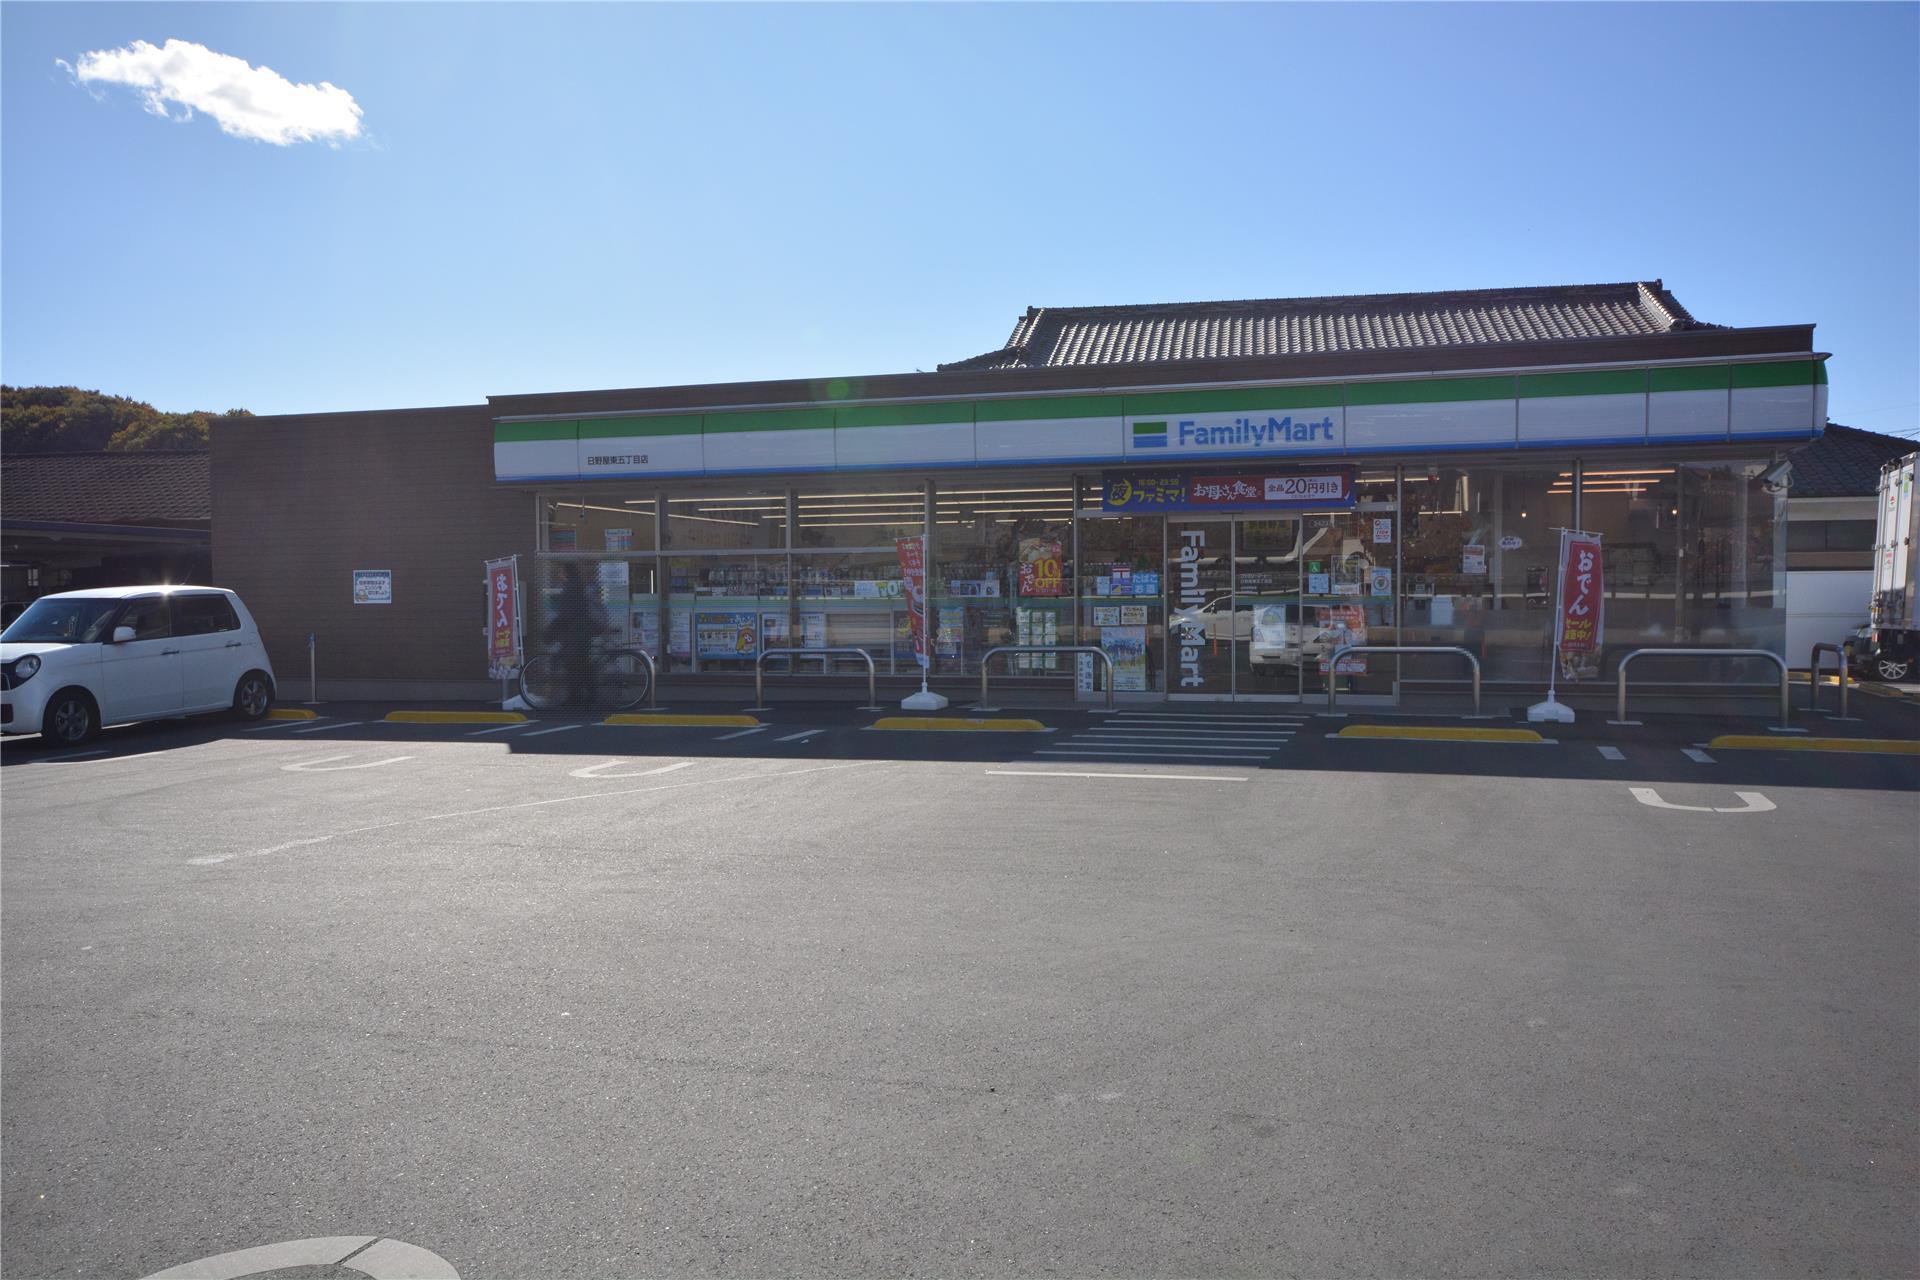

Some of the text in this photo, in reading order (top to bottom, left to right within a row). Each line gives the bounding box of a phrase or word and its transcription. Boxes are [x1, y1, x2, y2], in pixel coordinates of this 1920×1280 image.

[1179, 417, 1333, 447] FamilyMart
[1133, 487, 1185, 503] ファミマ!
[1194, 480, 1257, 500] お母さん食堂
[1268, 478, 1338, 494] 全品20円引き
[1020, 562, 1035, 592] おでん
[1035, 577, 1060, 589] OFF
[1568, 550, 1594, 616] おでん
[1174, 530, 1206, 687] FamilyMart
